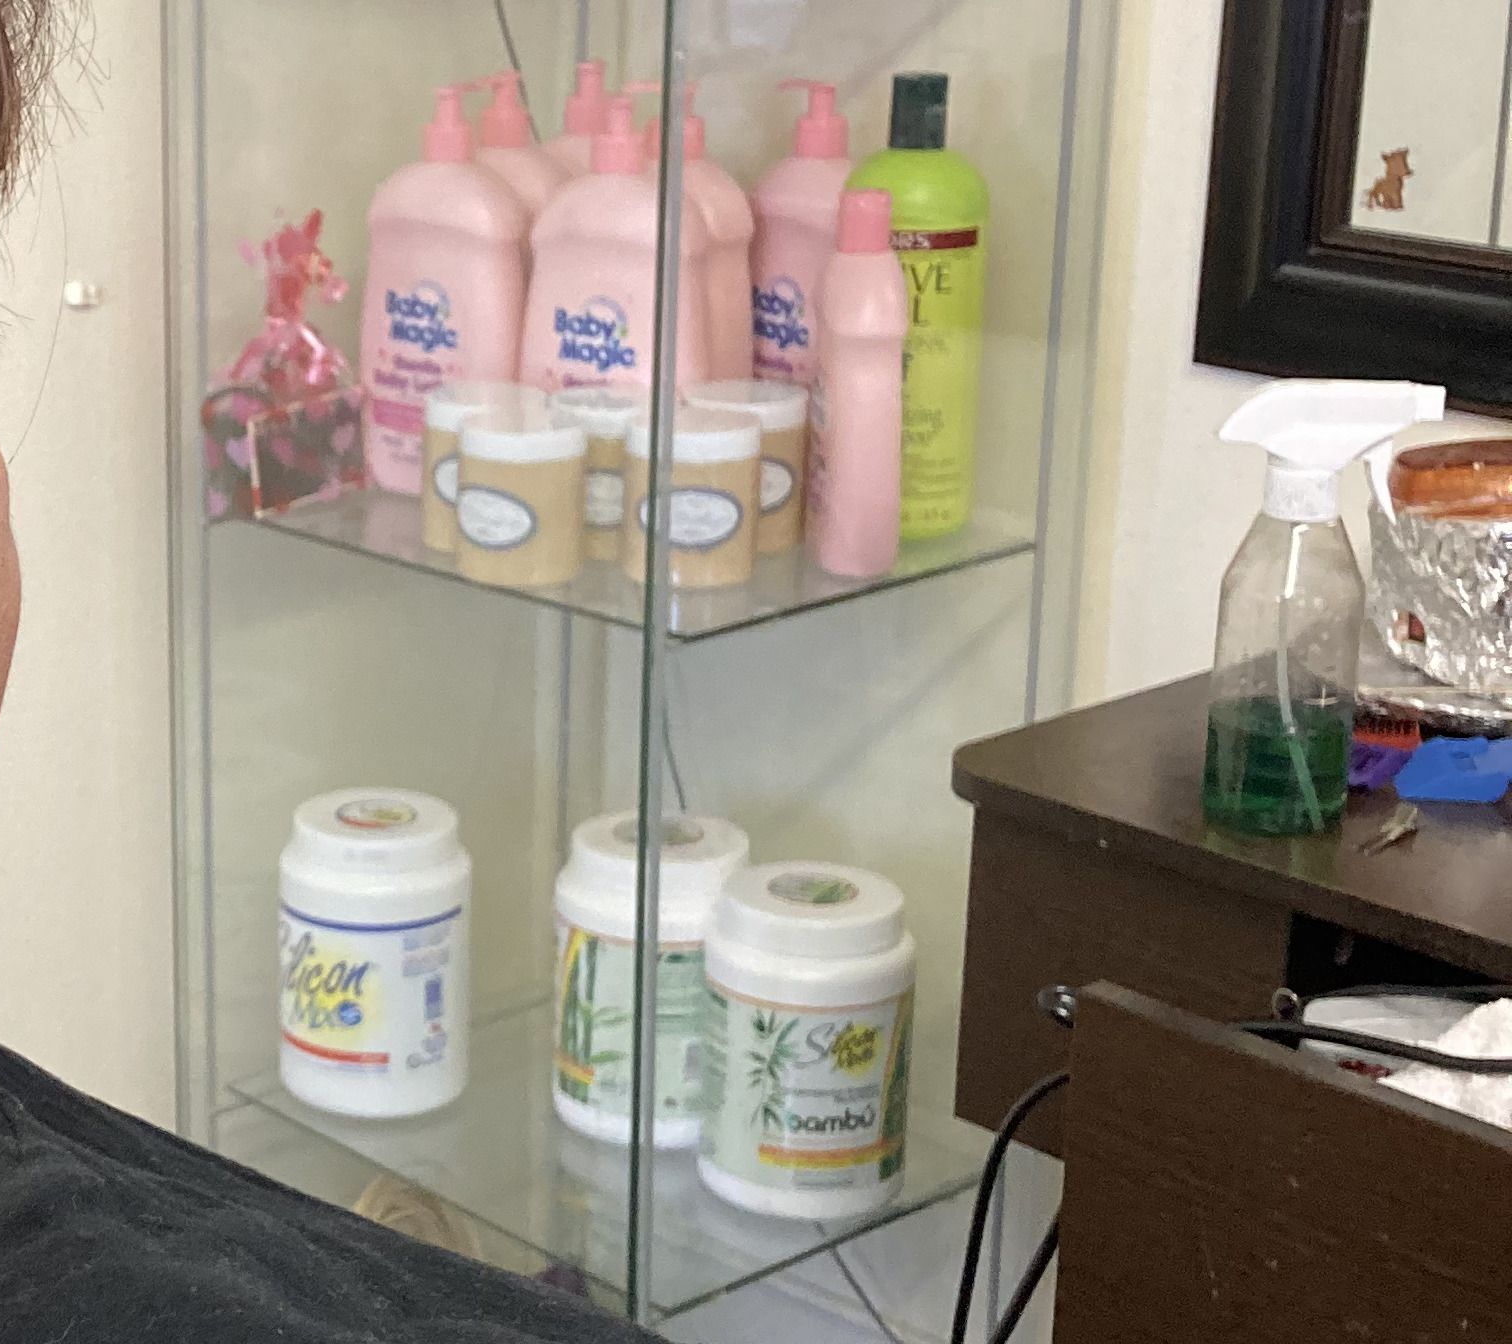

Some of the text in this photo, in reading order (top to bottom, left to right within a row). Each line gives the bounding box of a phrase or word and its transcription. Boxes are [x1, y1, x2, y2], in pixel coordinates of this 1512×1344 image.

[385, 288, 440, 321] Baby
[391, 320, 457, 353] Magic
[554, 306, 615, 338] Baby
[558, 337, 636, 372] Magic
